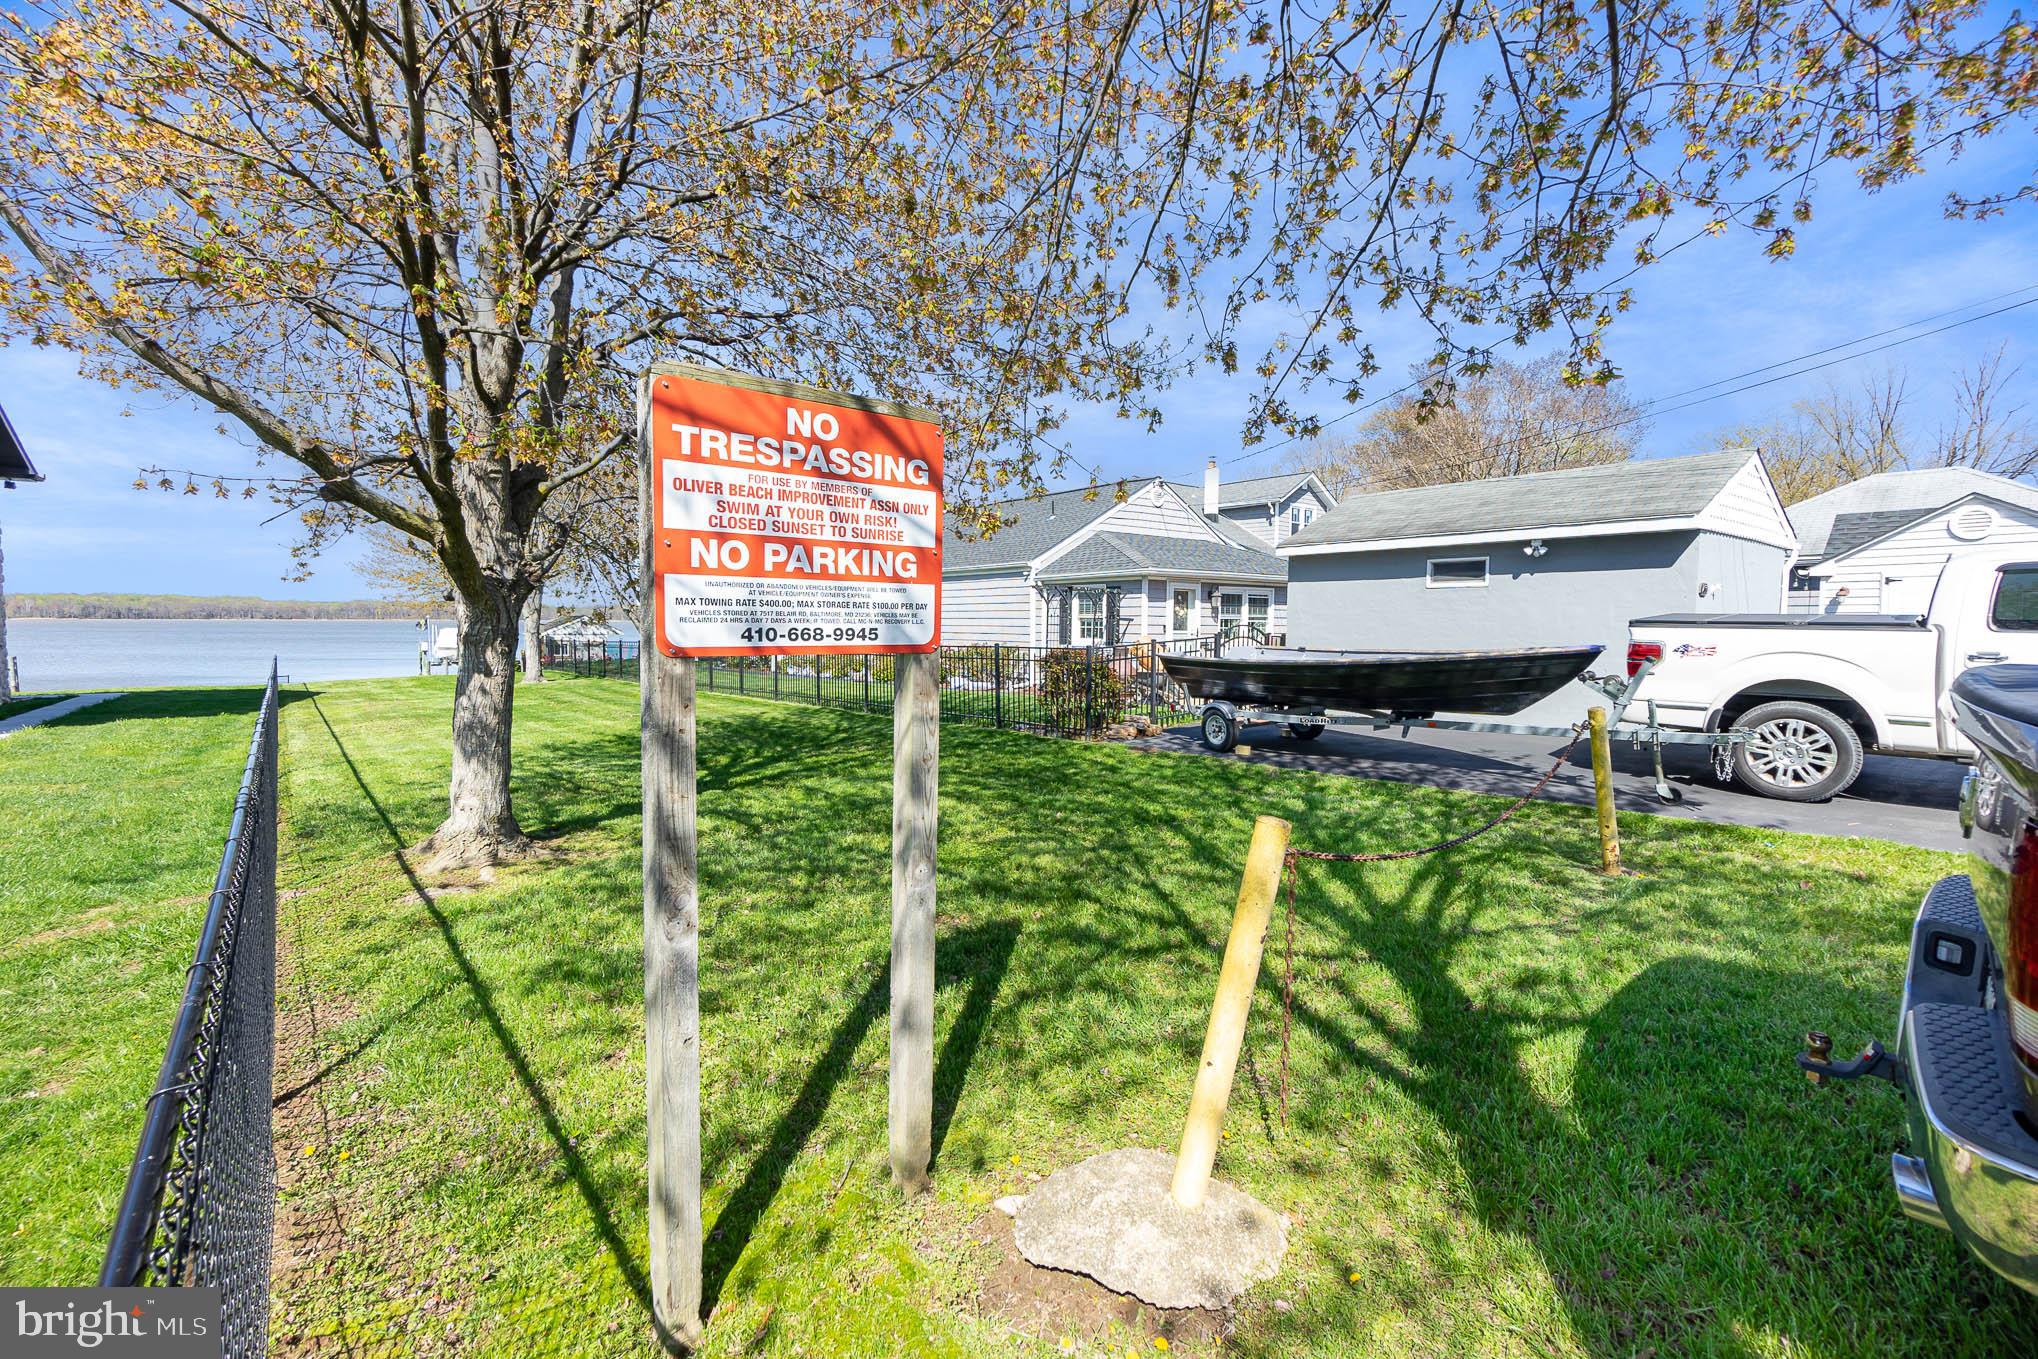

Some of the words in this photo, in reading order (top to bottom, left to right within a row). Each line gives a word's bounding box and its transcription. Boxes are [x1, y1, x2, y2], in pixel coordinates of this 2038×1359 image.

[786, 407, 840, 441] NO
[671, 423, 929, 486] TRESPASSING
[672, 477, 724, 495] OLIVER
[728, 483, 773, 501] BEACH
[777, 488, 866, 510] IMPROVEMENT
[870, 499, 900, 513] ASSN
[903, 502, 929, 516] ONLY
[748, 473, 769, 485] FOR
[772, 476, 792, 488] USE
[795, 479, 808, 489] BY
[811, 481, 859, 495] MEMBERS
[861, 487, 873, 497] OF
[716, 500, 760, 516] SWIM
[765, 505, 783, 518] AT
[787, 506, 824, 522] YOUR
[829, 510, 860, 524] OWN
[864, 514, 897, 528] RISK!
[708, 514, 767, 532] CLOSED
[772, 520, 826, 536] SUNSET
[830, 525, 847, 538] TO
[851, 526, 905, 542] SUNRISE
[690, 537, 750, 570] NO
[763, 542, 918, 578] PARKING
[704, 580, 755, 589] UNAUTHORIZED
[675, 597, 696, 606] MAX
[700, 597, 733, 607] TOWING
[735, 598, 757, 607] RATE
[759, 599, 795, 609] $400.00;
[796, 600, 815, 608] MAX
[817, 600, 851, 609] STORAGE
[852, 601, 870, 610] RATE
[872, 602, 899, 610] $100.00
[900, 602, 914, 610] PER
[915, 603, 928, 611] DAY
[723, 609, 749, 617] STORED
[679, 616, 719, 624] RECLAIMED
[740, 627, 879, 643] 410-668-9945
